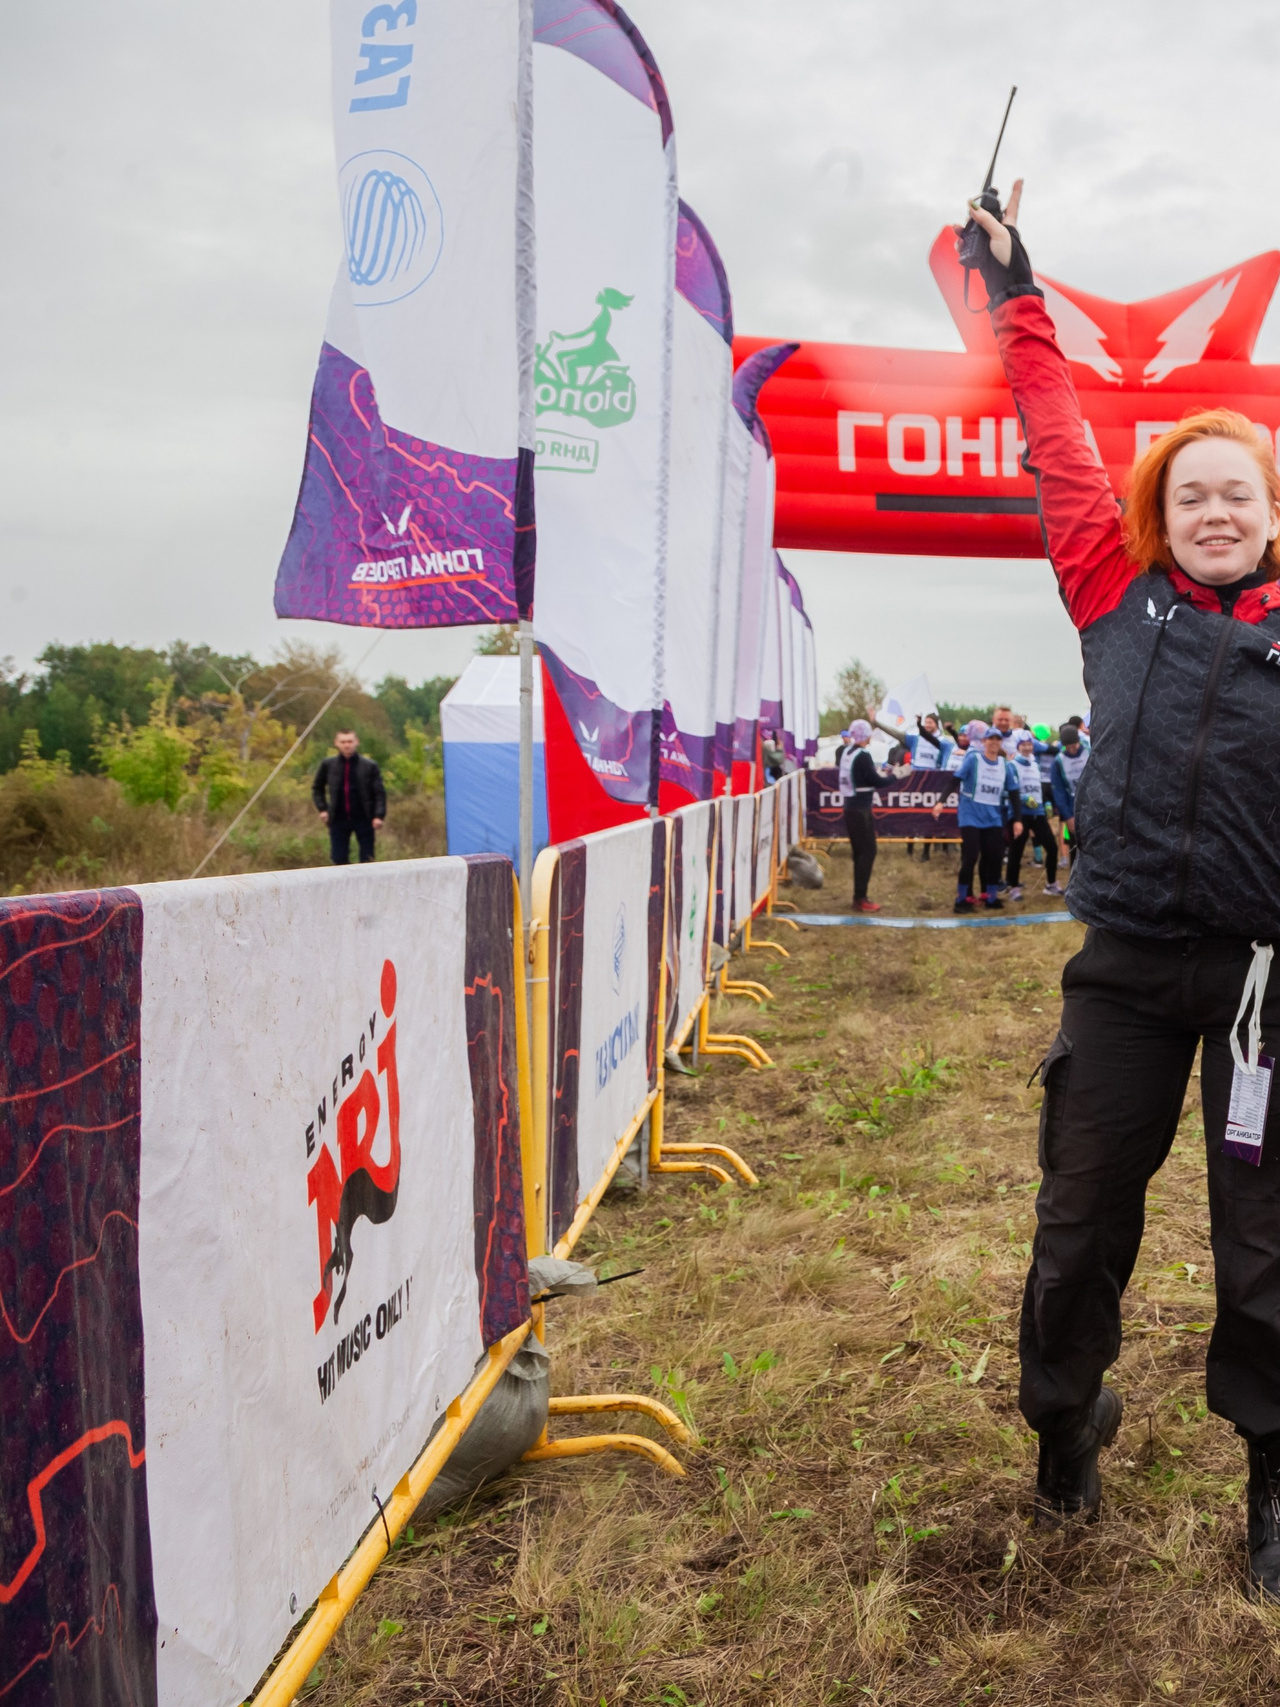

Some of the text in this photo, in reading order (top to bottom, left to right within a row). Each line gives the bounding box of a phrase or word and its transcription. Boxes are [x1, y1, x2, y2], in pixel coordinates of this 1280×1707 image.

[837, 410, 1107, 477] ГОН
[820, 792, 959, 807] ГОА ГЕРОВ
[1227, 1128, 1261, 1141] ОРГАНИЗАТОР
[317, 1350, 336, 1405] HIT
[337, 1313, 372, 1382] MUSIC
